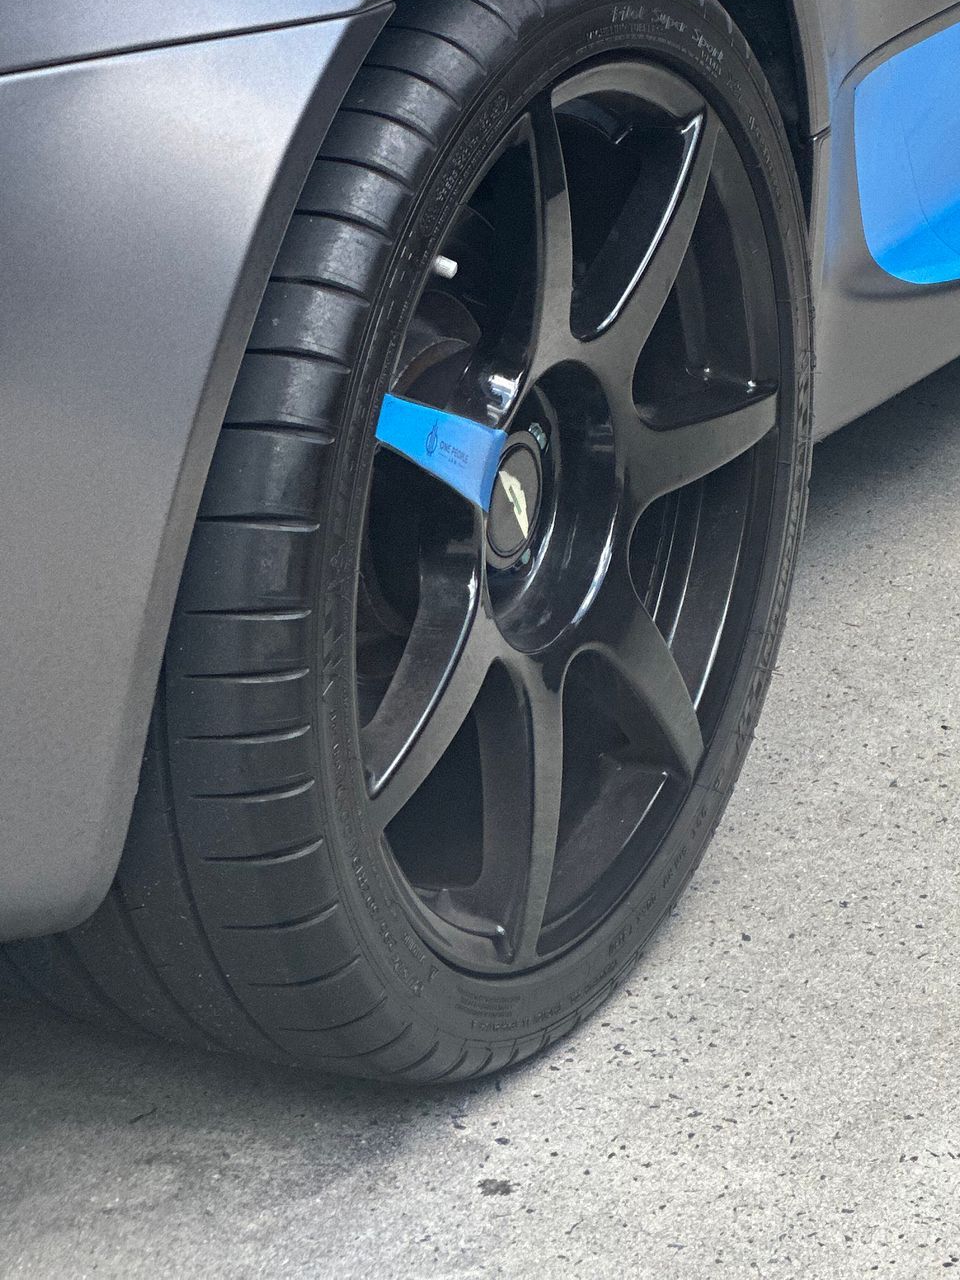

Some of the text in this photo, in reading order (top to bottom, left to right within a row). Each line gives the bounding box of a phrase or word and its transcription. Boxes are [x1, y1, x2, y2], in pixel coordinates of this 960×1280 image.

[611, 5, 645, 23] Pilot
[651, 8, 688, 32] Super
[691, 28, 724, 62] Sport
[439, 440, 469, 464] ONE PEOPLE
